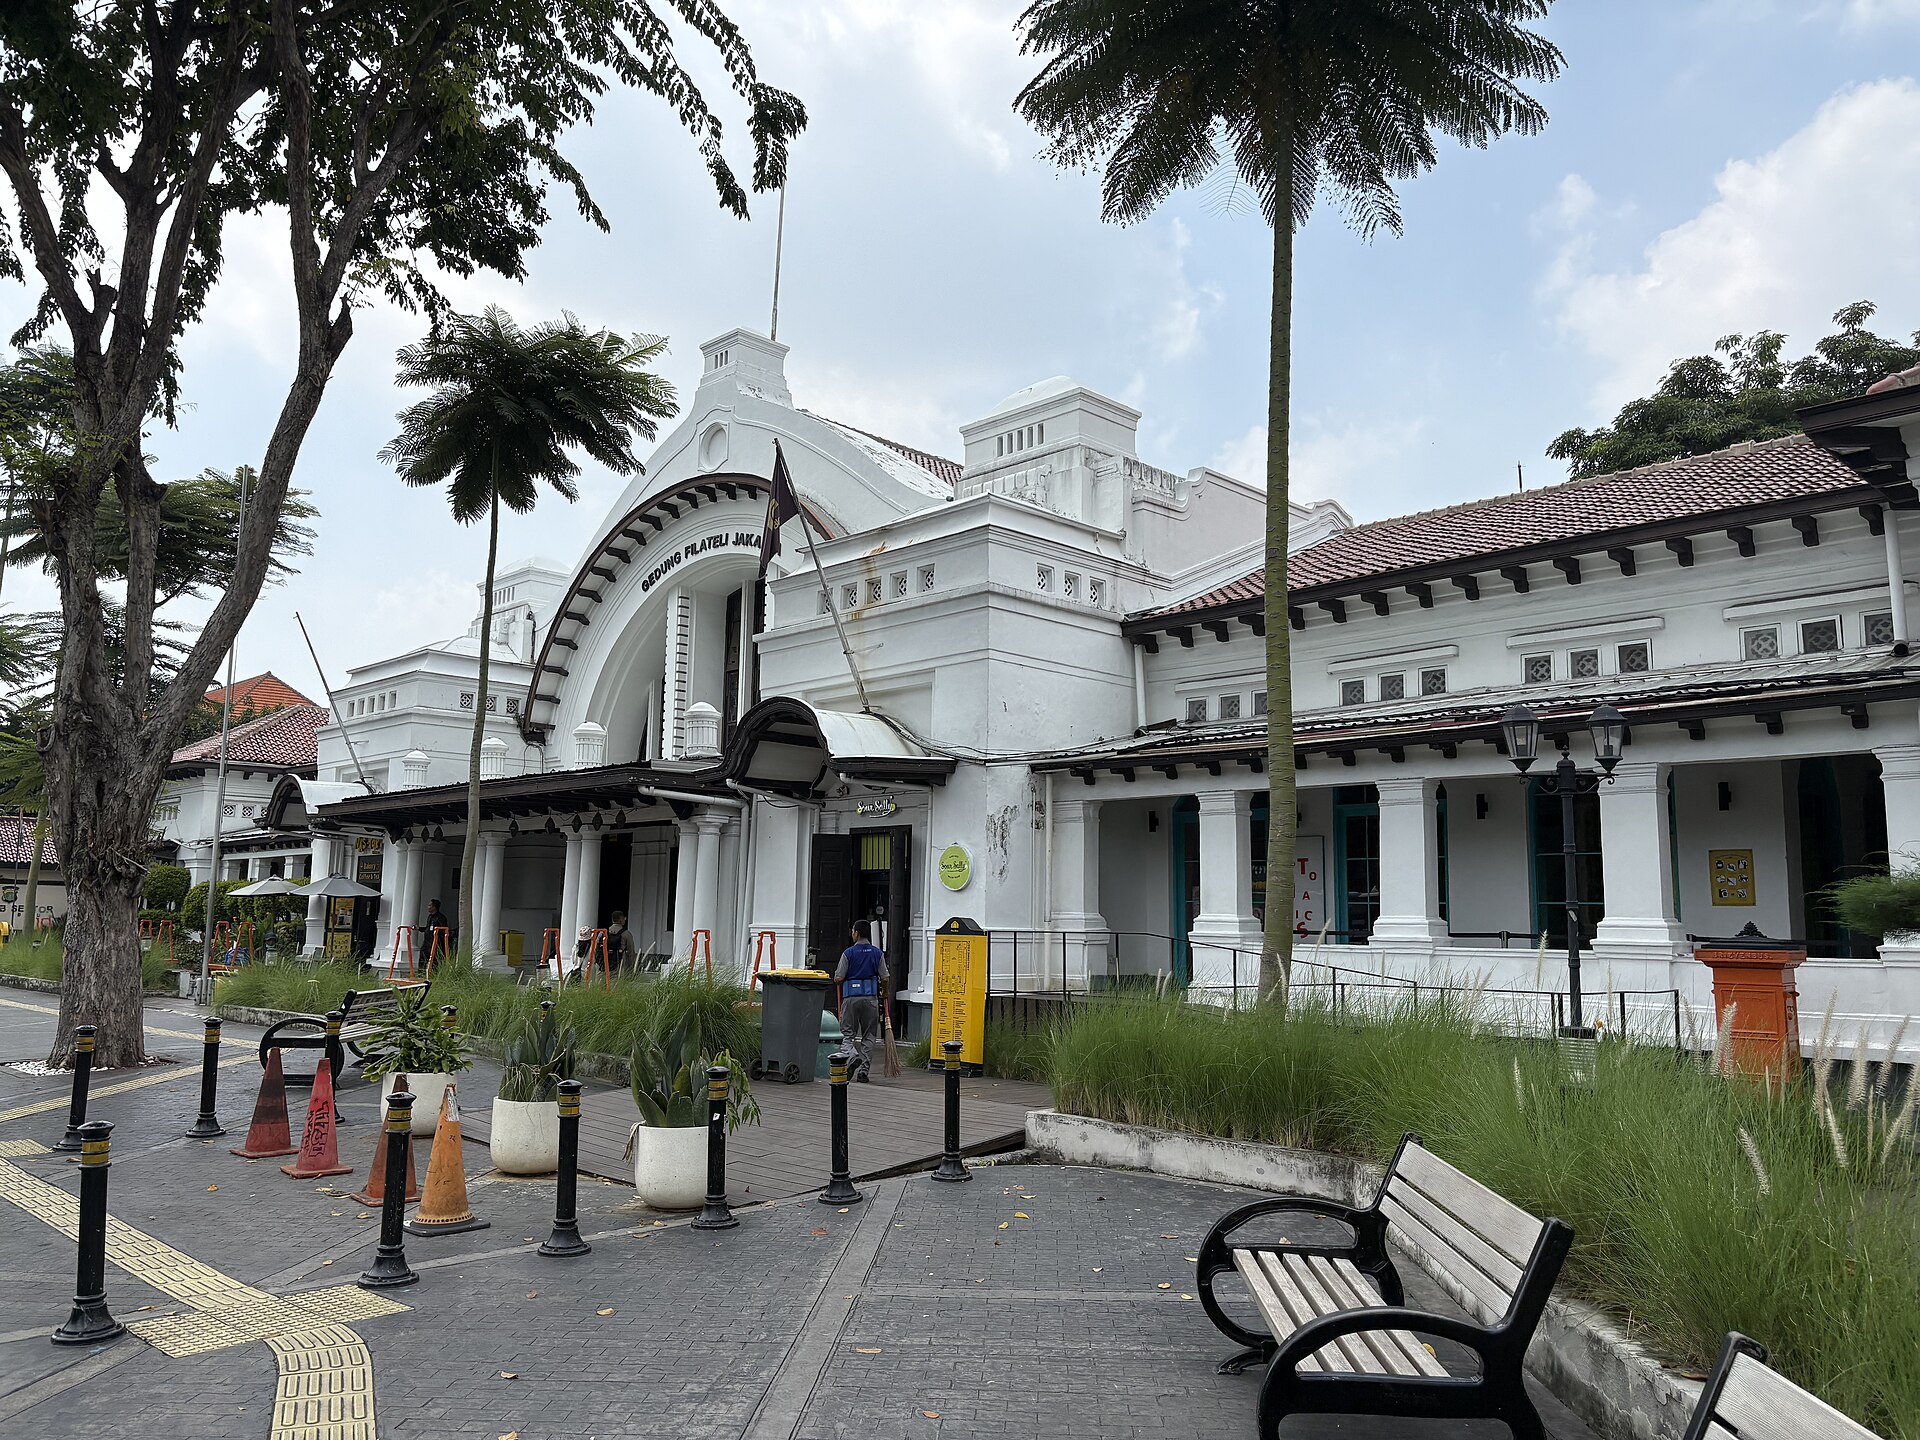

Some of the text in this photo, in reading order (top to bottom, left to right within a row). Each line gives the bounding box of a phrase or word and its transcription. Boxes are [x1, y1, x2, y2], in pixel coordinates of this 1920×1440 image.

[641, 551, 682, 592] GEDUNG
[684, 532, 730, 559] FILATELI
[857, 799, 896, 818] Sour Sally
[941, 862, 953, 870] Sour
[11, 905, 54, 913] SEOR
